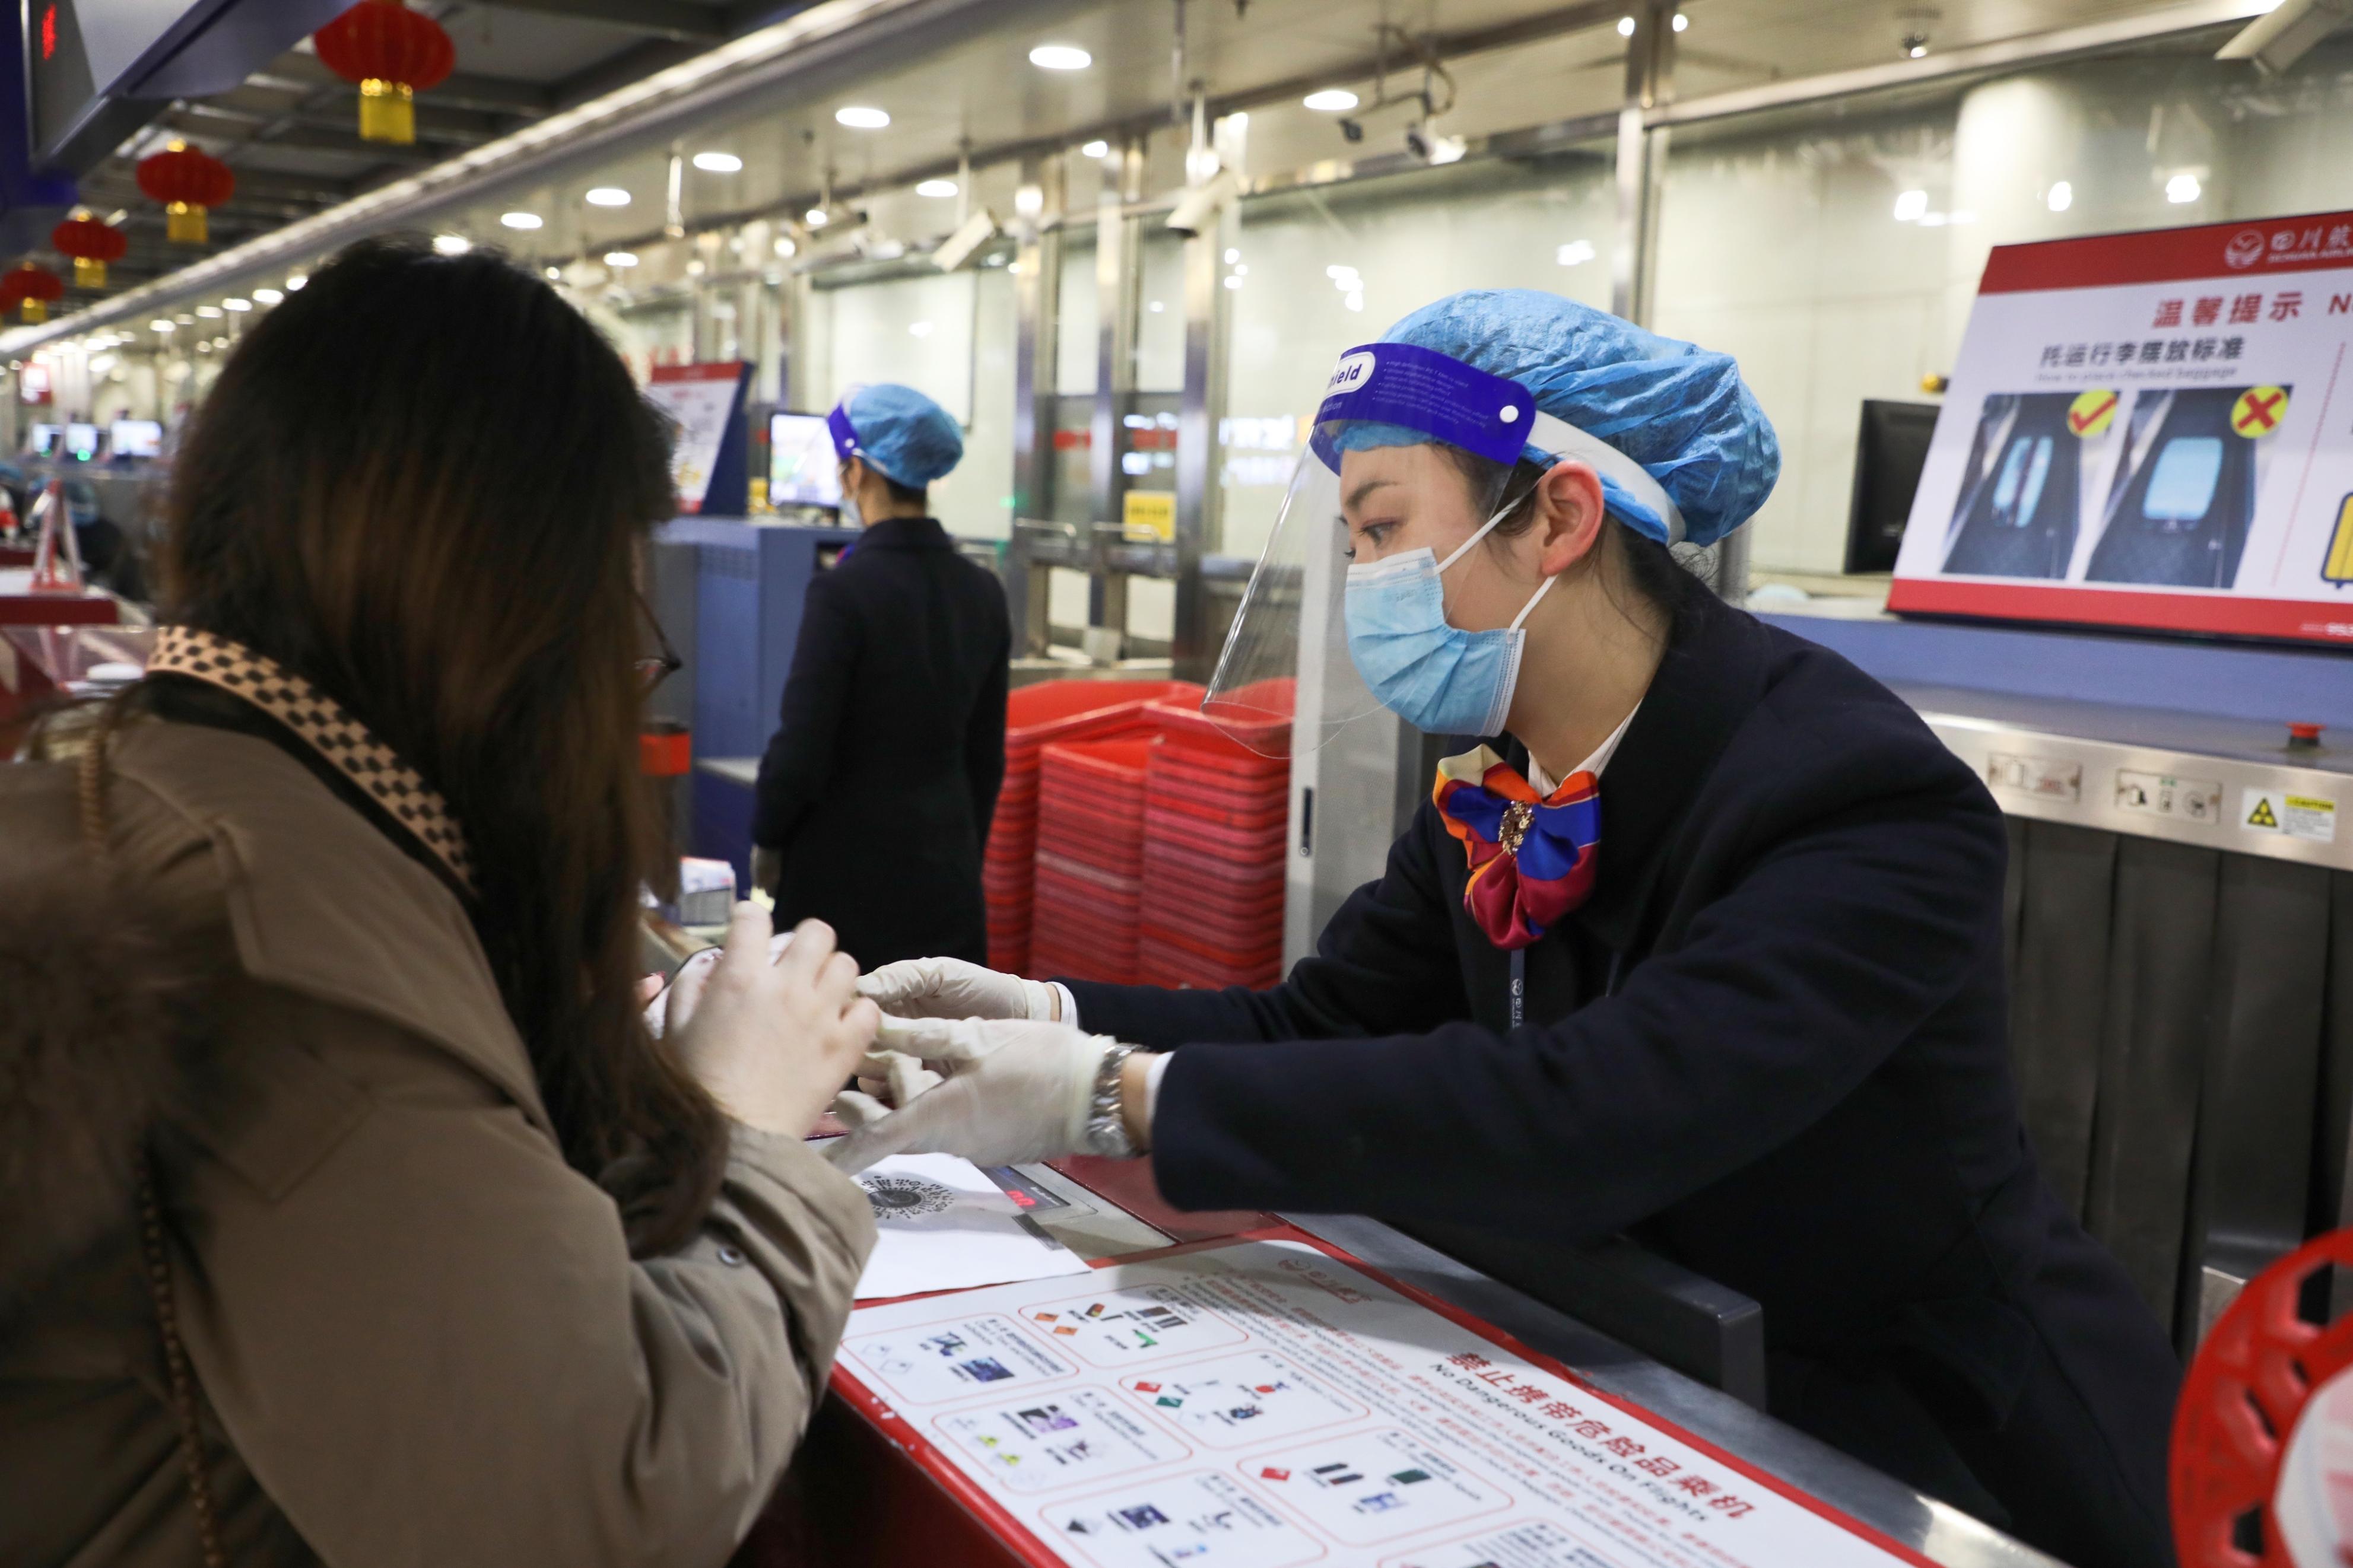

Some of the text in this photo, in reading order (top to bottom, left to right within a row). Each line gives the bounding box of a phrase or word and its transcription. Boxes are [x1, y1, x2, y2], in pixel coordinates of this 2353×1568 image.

[2152, 291, 2303, 329] 温馨提示
[1430, 1363, 1455, 1378] No
[1455, 1377, 1547, 1430] Dangerous
[1548, 1429, 1605, 1464] Goods
[1608, 1463, 1637, 1482] On
[1638, 1480, 1707, 1521] Flights
[1446, 1352, 1756, 1518] 禁止携带危险品乘机
